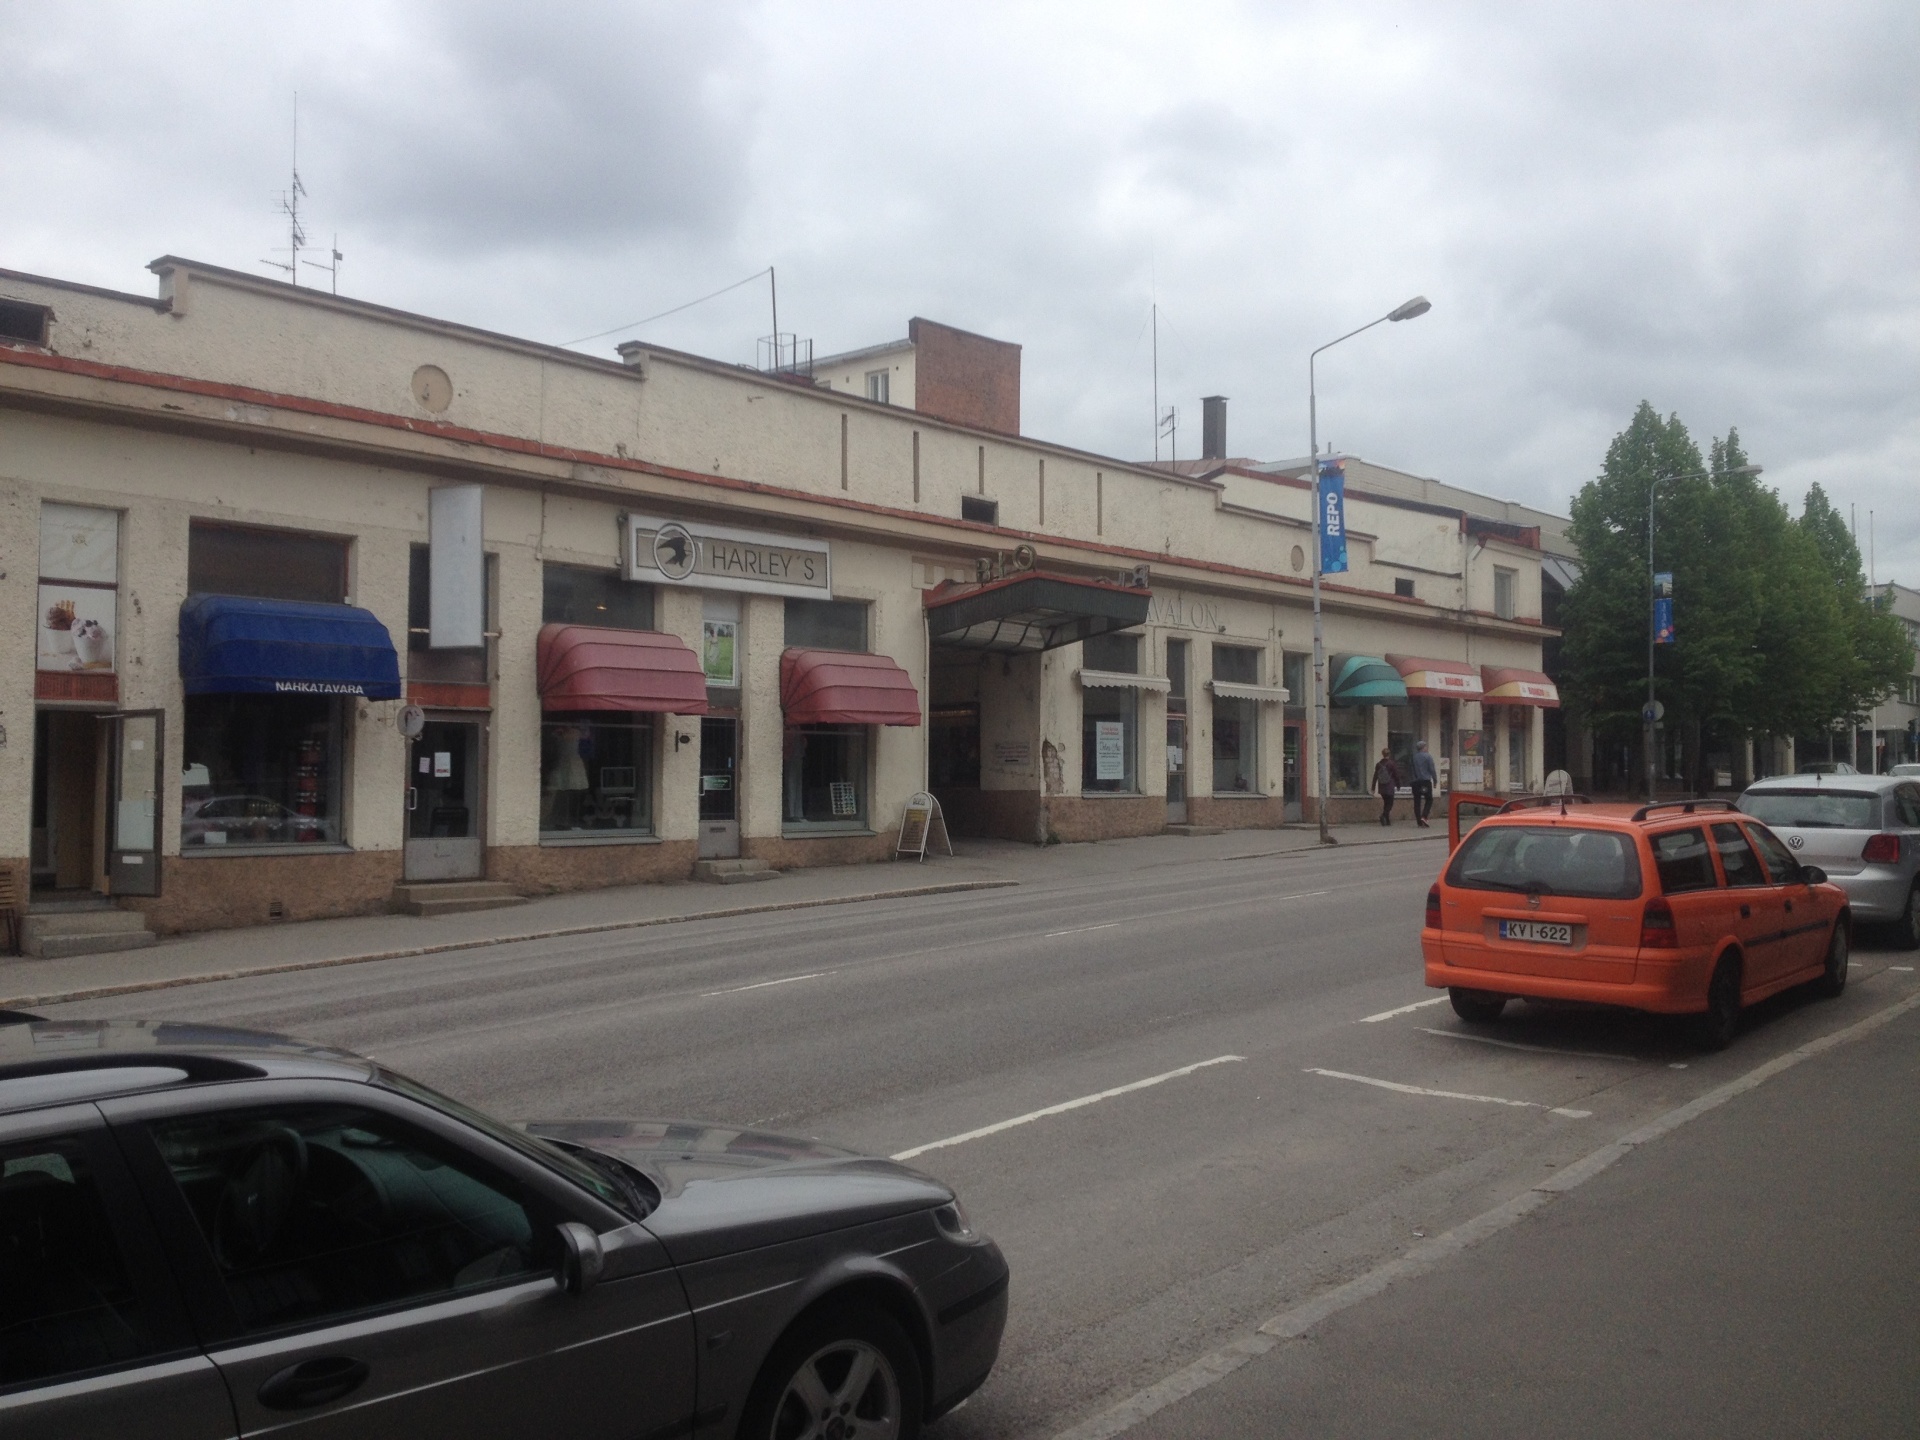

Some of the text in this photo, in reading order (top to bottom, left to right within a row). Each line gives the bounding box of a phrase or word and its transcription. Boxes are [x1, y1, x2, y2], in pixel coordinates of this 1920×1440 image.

[1326, 492, 1340, 536] REPO
[975, 544, 1037, 584] BIO
[275, 681, 364, 694] NAHKATAVARA
[1508, 922, 1568, 941] KVI-622
